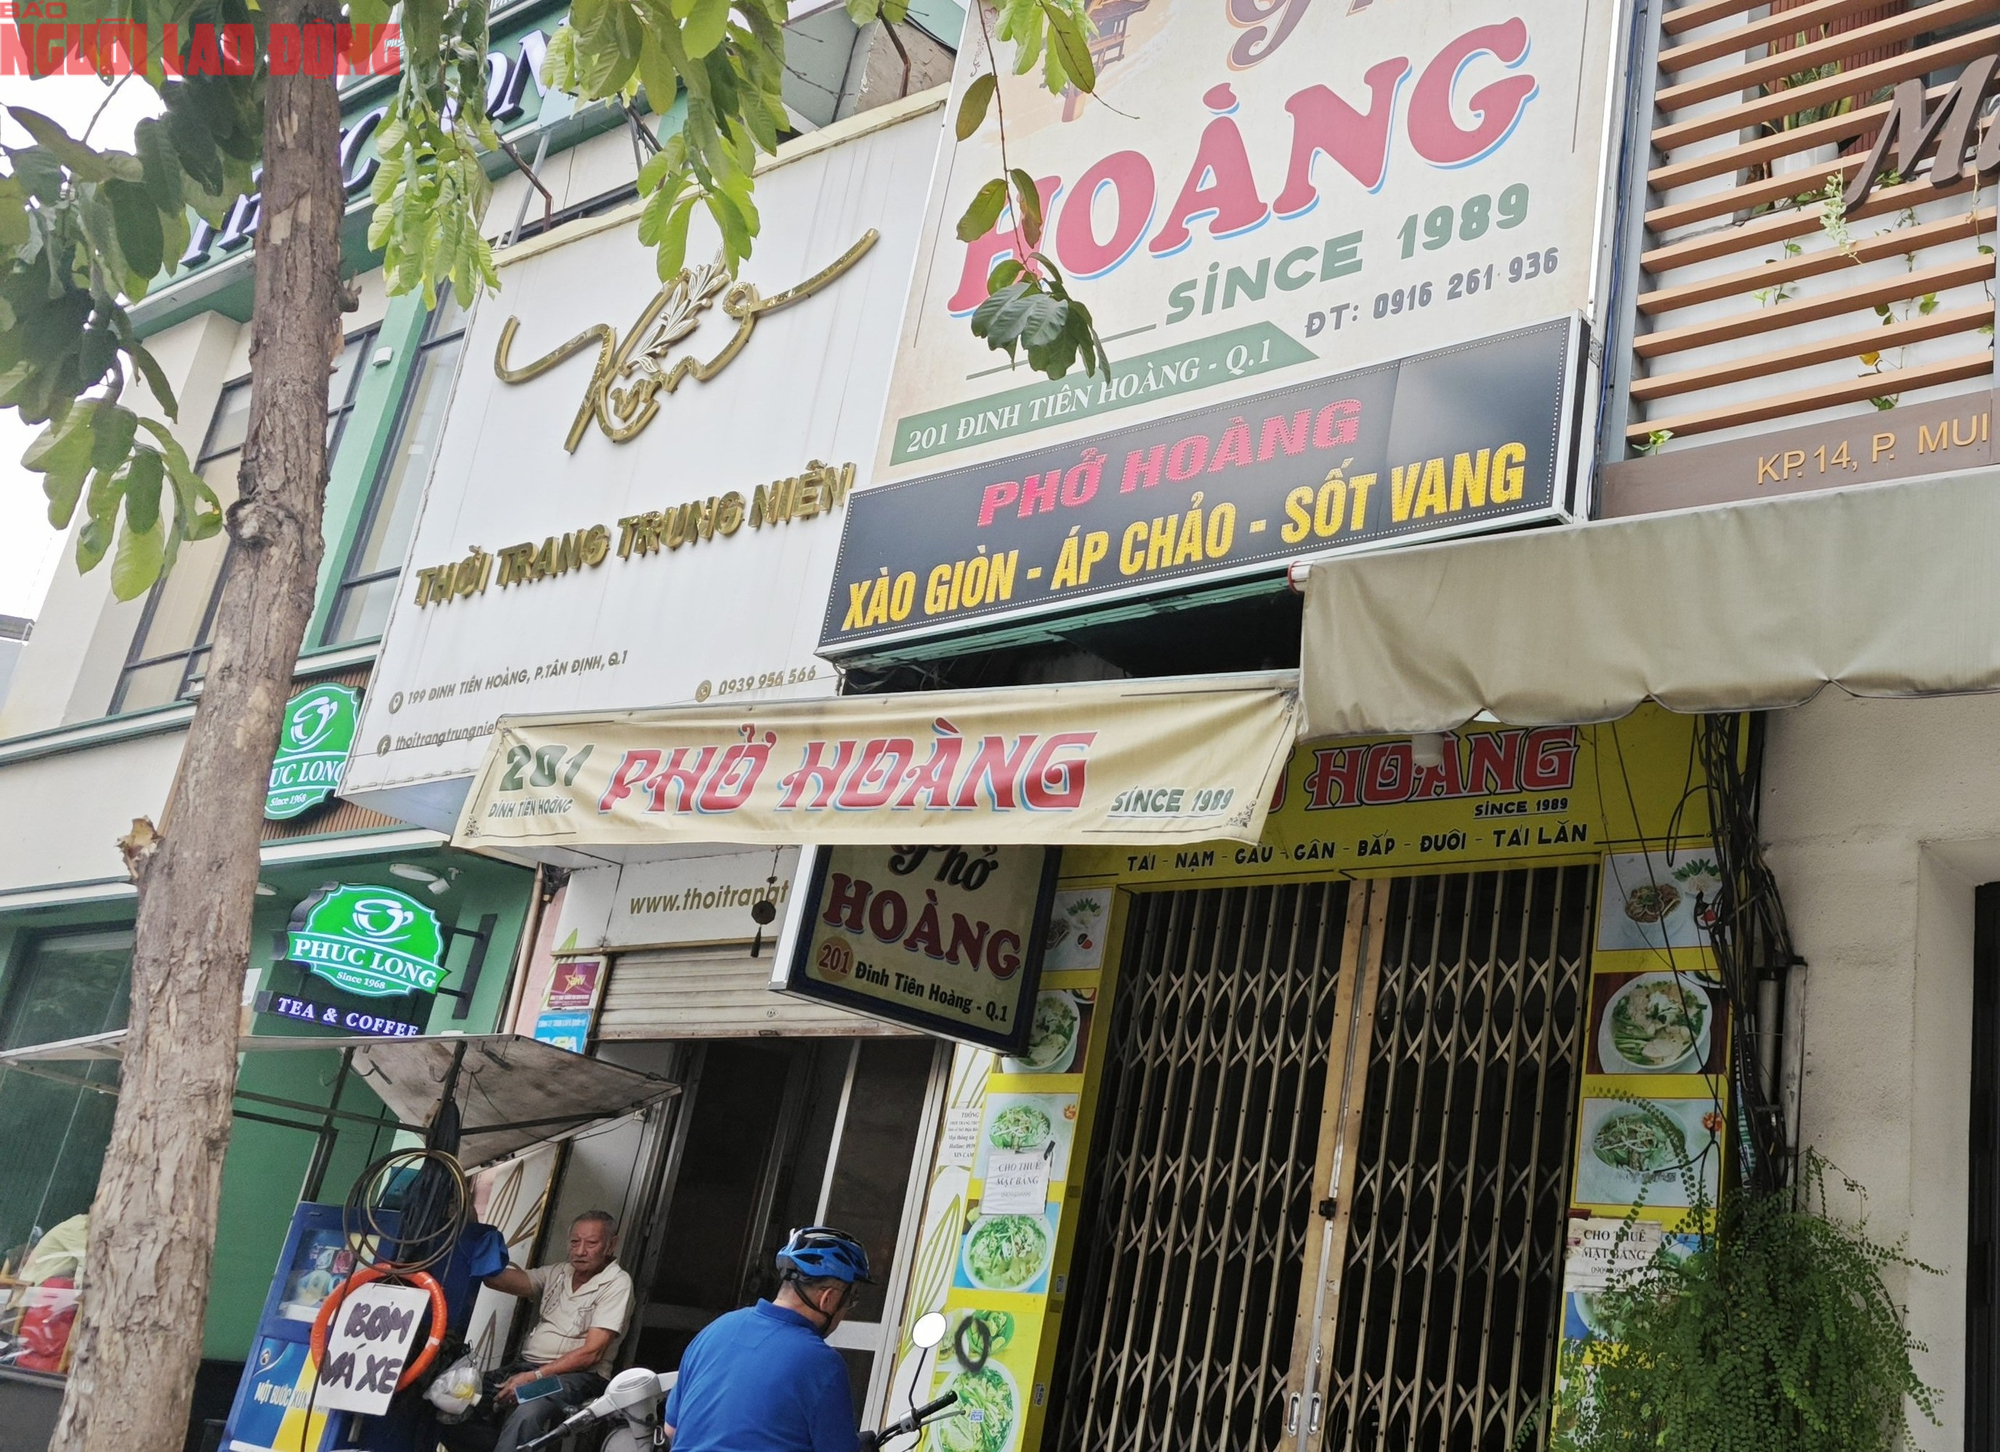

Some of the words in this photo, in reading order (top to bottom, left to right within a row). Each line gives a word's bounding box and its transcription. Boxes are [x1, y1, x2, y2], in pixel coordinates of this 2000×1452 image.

[947, 17, 1540, 317] HOÀNG
[1397, 183, 1530, 259] 1989
[1304, 303, 1358, 338] ĐT:
[1373, 281, 1432, 320] 0916
[1447, 264, 1493, 301] 261
[1508, 247, 1559, 283] 936
[906, 424, 948, 454] 201
[957, 406, 1020, 442] ĐINH
[1029, 386, 1094, 423] TIÊN
[1097, 357, 1200, 405] HOÀNG
[1225, 339, 1272, 376] Q.1
[977, 446, 1107, 527] PHỞ
[1119, 399, 1363, 494] HOÀNG
[414, 545, 494, 610] THỜI
[495, 523, 611, 589] TRANG
[616, 490, 745, 560] TRUNG
[841, 567, 917, 632] XÀO
[924, 545, 1019, 616] GIÒN
[1050, 525, 1109, 591] ÁP
[1119, 491, 1237, 576] CHẢO
[1281, 458, 1378, 544] SỐT
[1389, 441, 1527, 523] VANG
[407, 690, 426, 705] 199
[428, 684, 455, 702] ĐINH
[459, 675, 482, 695] TIÊN
[485, 667, 530, 689] HOÀNG,
[571, 654, 605, 677] ĐỊNH,
[608, 650, 628, 666] Q.1
[718, 676, 755, 695] 0939
[758, 671, 784, 689] 956
[788, 665, 816, 684] 566
[499, 744, 594, 791] 201
[597, 723, 778, 815] PHỞ
[774, 717, 1098, 813] HOÀNG
[1190, 788, 1234, 812] 1989
[1536, 798, 1568, 812] 1989
[1127, 853, 1156, 871] TÁI
[1175, 850, 1214, 872] NẠM
[1294, 838, 1335, 860] GÂN
[1357, 829, 1395, 857] BẮP
[1420, 828, 1467, 852] ĐUÔI
[1493, 824, 1529, 847] TÁI
[1538, 819, 1587, 844] LĂN
[822, 872, 1021, 980] HOÀNG
[292, 938, 366, 966] PHUC
[369, 951, 437, 988] LONG
[337, 971, 362, 984] Since
[364, 977, 386, 989] 1968
[818, 943, 850, 974] 201
[278, 996, 315, 1019] TEA
[322, 1007, 339, 1024] &
[345, 1012, 419, 1037] COFFEE
[855, 961, 890, 988] Đinh
[894, 972, 924, 998] Tiên
[928, 983, 973, 1014] Hoàng
[985, 1001, 1008, 1022] Q.1
[998, 1162, 1017, 1172] CHO
[1019, 1158, 1042, 1171] THUÊ
[1583, 1230, 1610, 1240] CHO
[355, 1354, 402, 1394] XE
